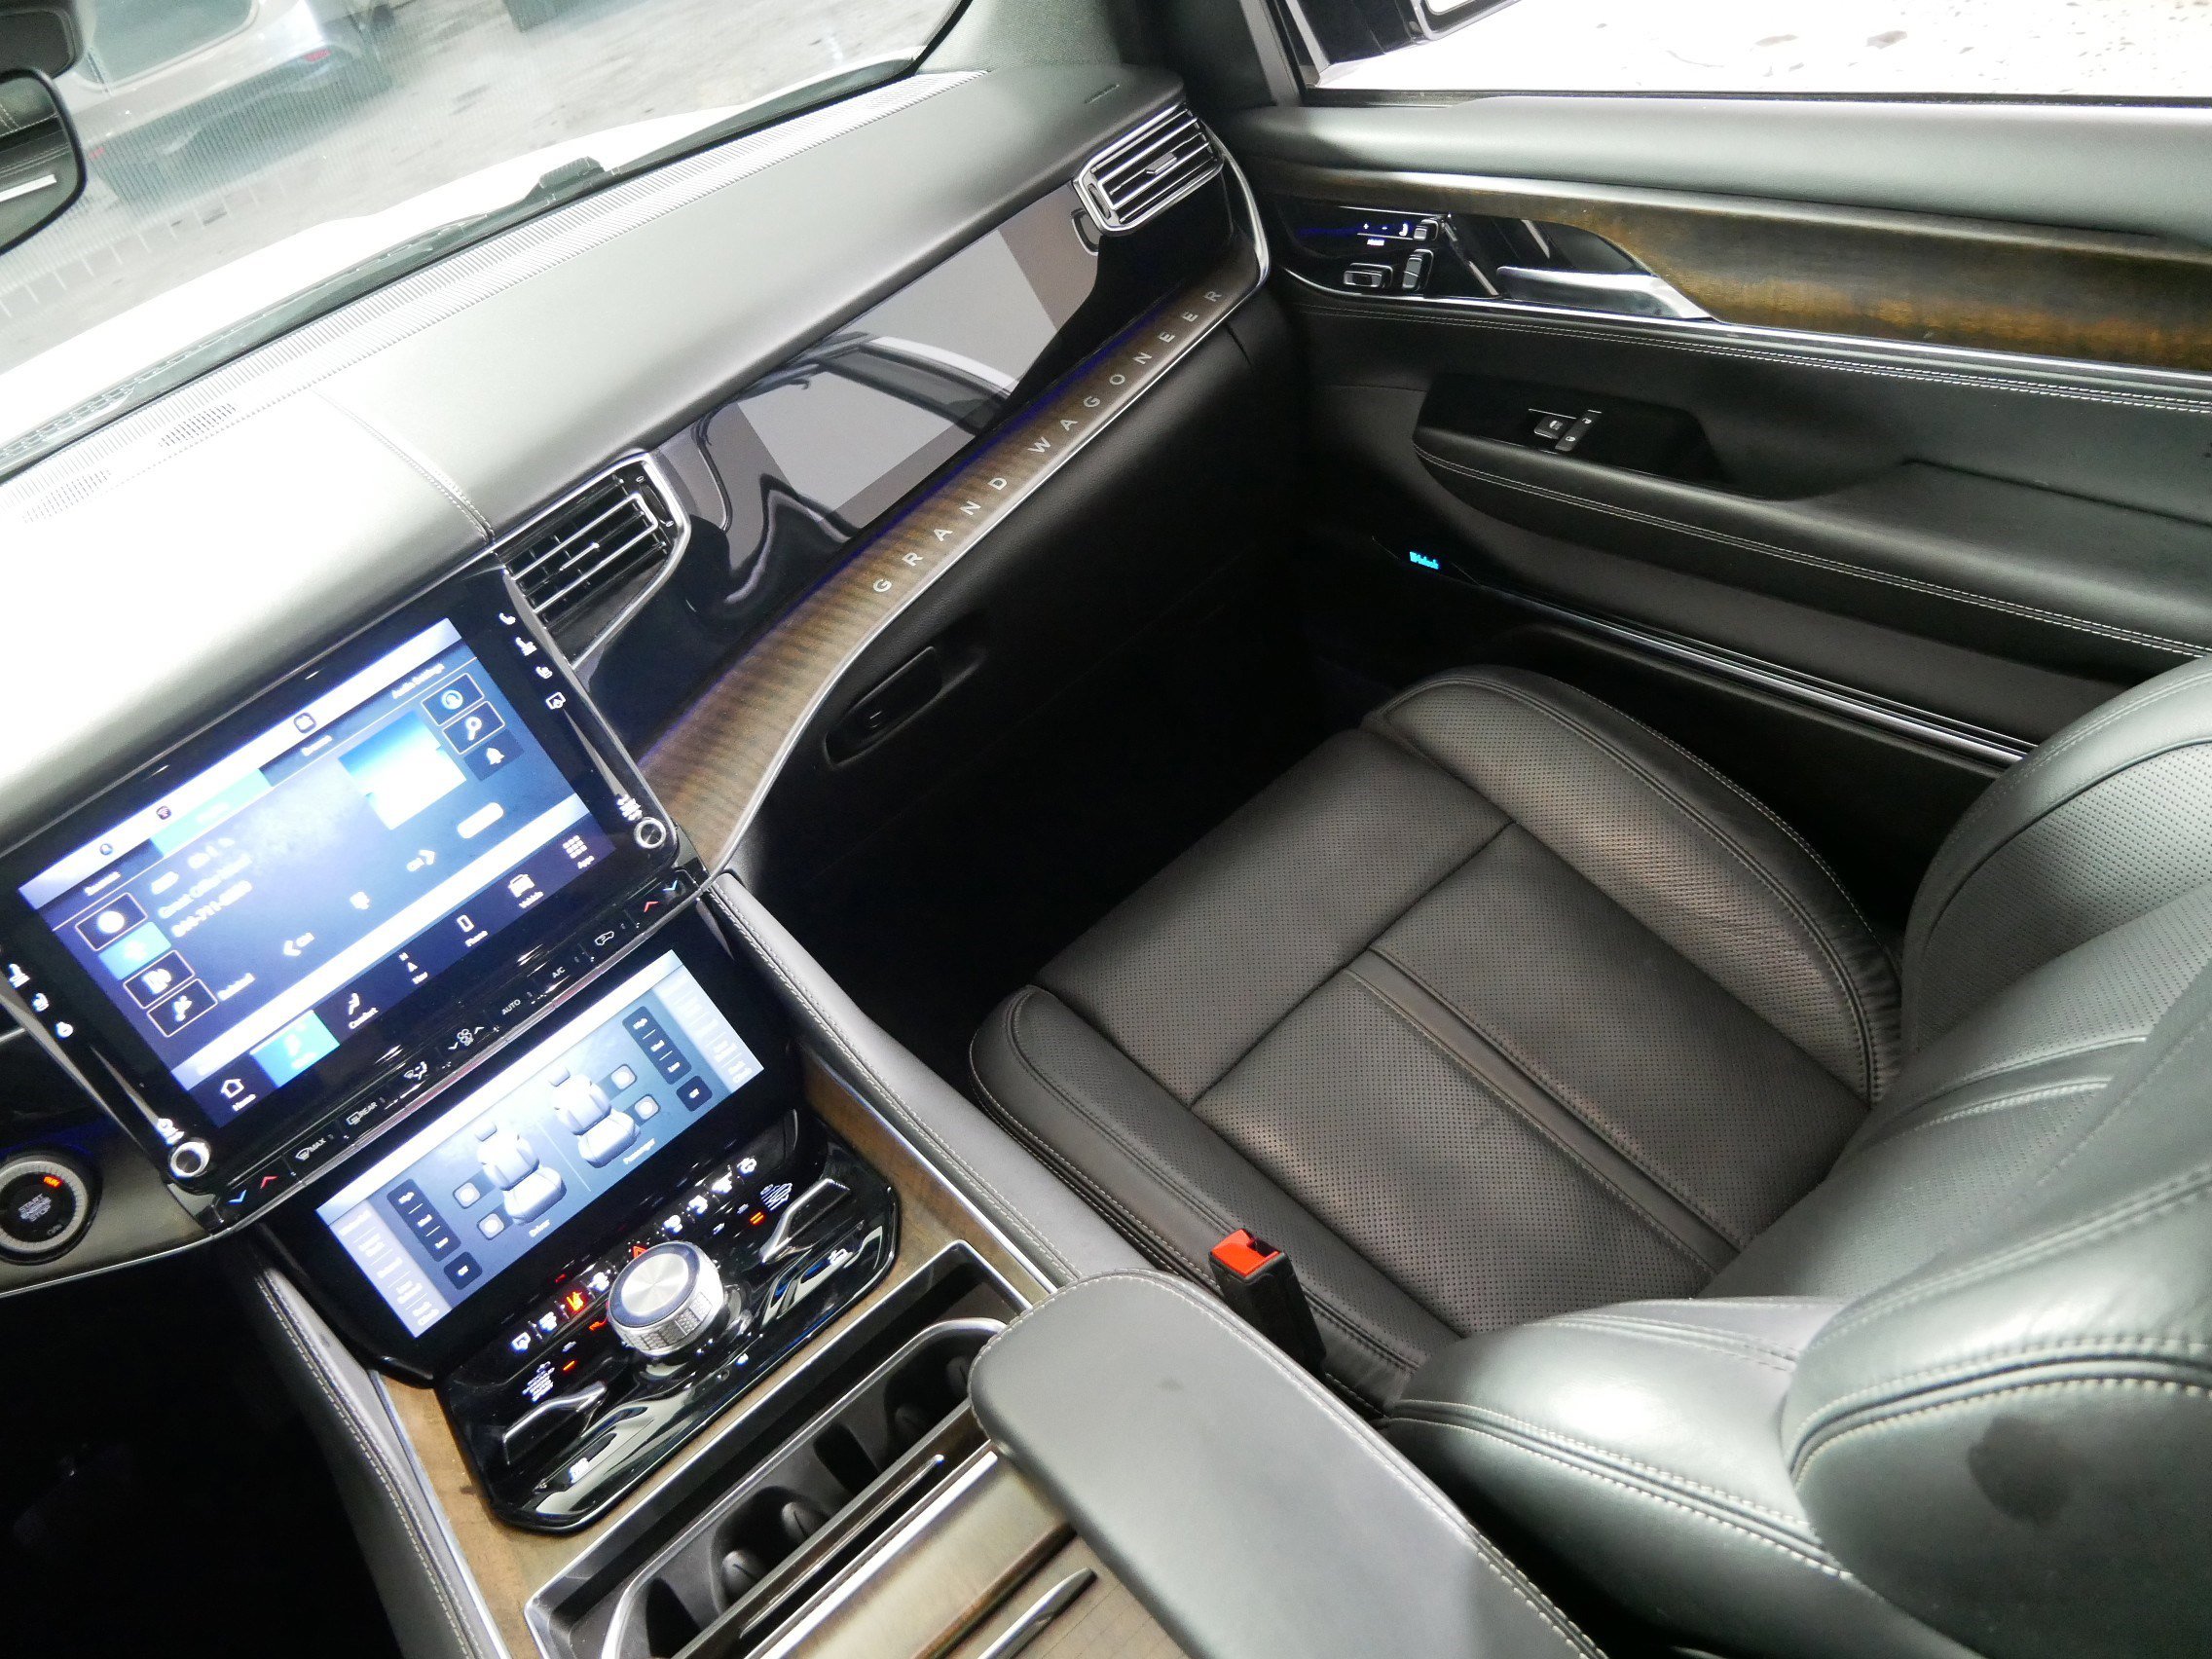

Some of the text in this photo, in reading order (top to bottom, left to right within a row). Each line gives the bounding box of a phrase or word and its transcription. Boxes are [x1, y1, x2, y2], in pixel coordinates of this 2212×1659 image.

[872, 289, 1223, 594] GRAND WAGONEER
[551, 966, 566, 979] A/C
[501, 998, 522, 1015] AUTO
[358, 1101, 378, 1119] REAR
[309, 1137, 327, 1153] MAX
